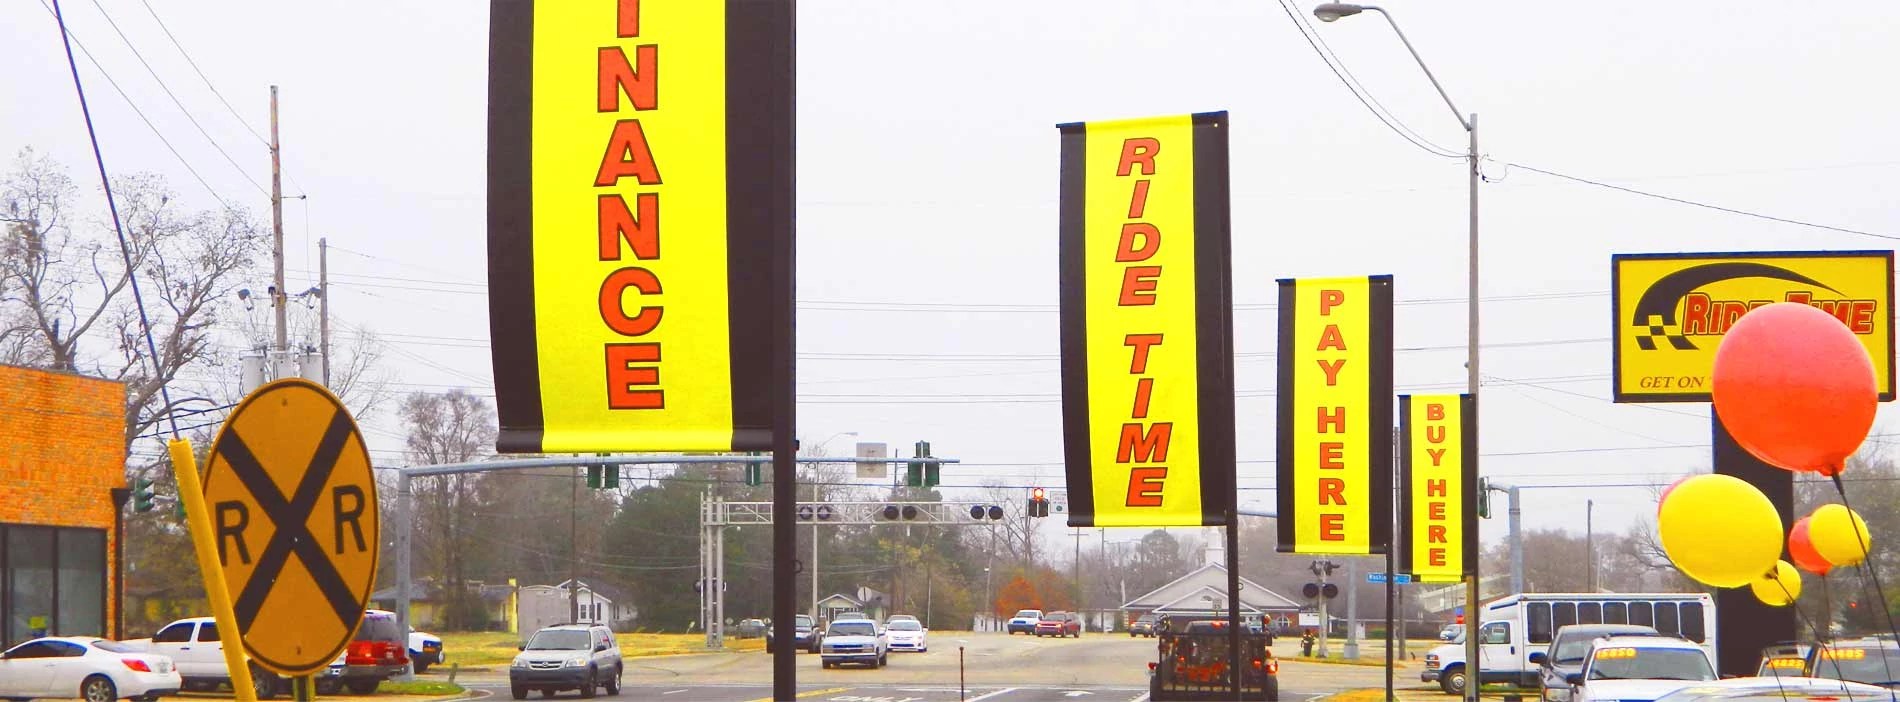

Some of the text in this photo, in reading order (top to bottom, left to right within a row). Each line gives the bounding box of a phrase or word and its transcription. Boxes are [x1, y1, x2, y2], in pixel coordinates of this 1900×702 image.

[1115, 137, 1173, 507] RIDE TIME
[1683, 292, 1774, 335] RID
[1316, 289, 1347, 541] PAY HERE
[1640, 375, 1674, 389] GET
[1677, 375, 1705, 389] ON
[215, 484, 367, 567] R R
[1426, 403, 1447, 566] BUY HERE
